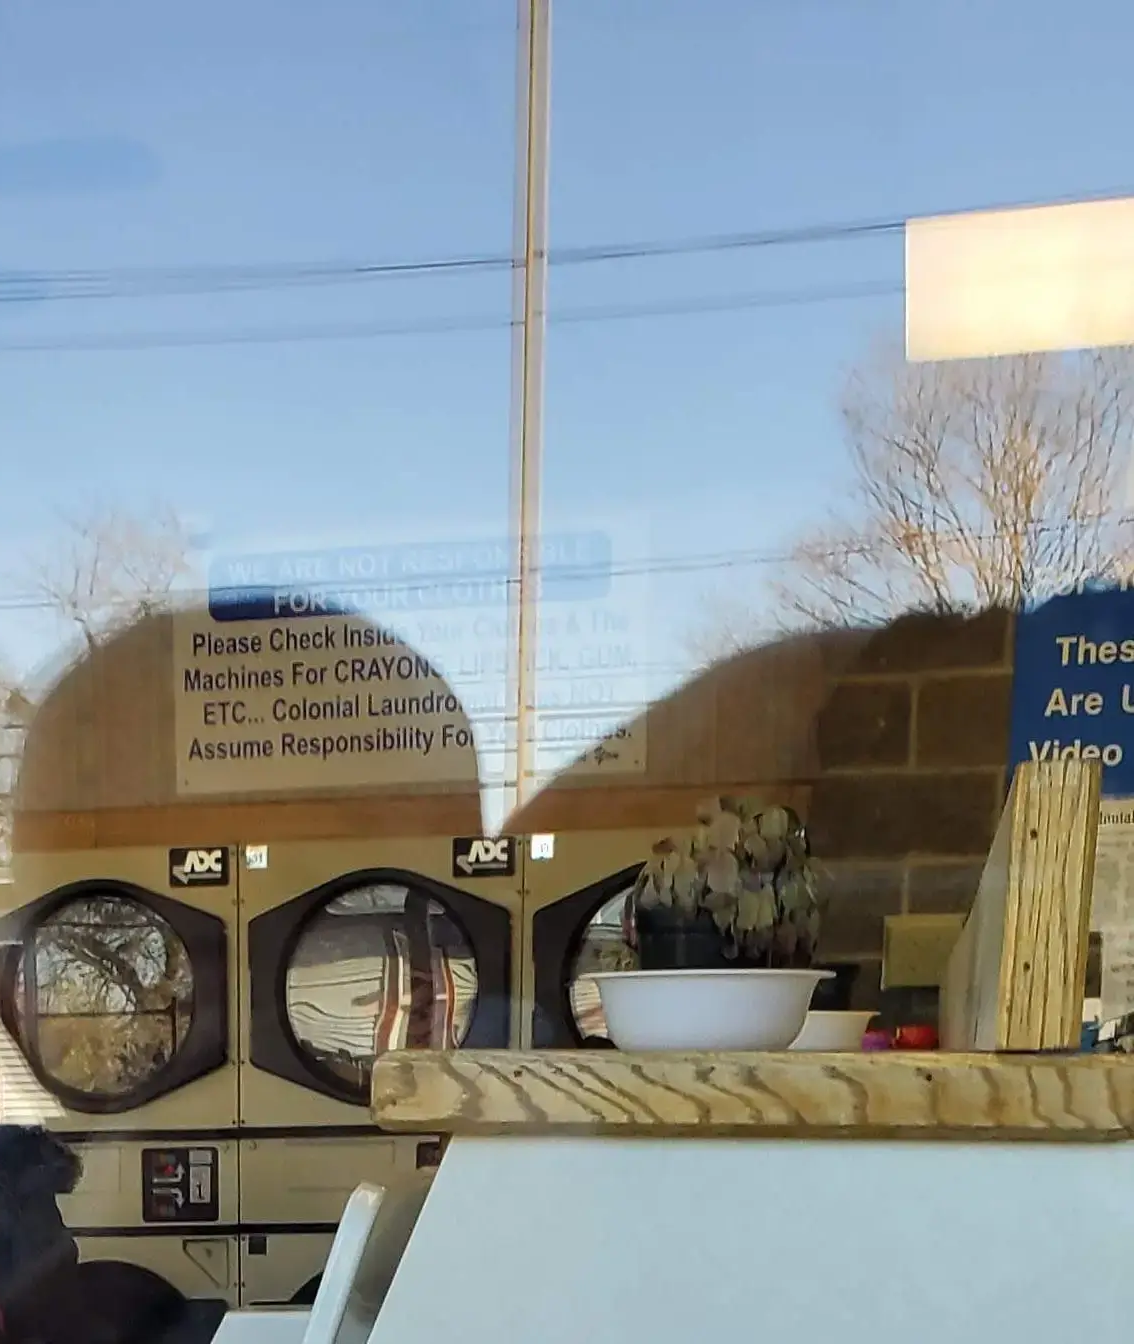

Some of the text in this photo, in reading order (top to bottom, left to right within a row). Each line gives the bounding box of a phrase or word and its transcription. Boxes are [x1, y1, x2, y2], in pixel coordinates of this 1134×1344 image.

[227, 560, 267, 585] WE
[278, 556, 328, 580] ARE
[338, 553, 390, 577] NOT
[274, 590, 328, 615] FOR
[418, 577, 543, 606] CLOTHS
[192, 631, 262, 657] Please
[269, 624, 336, 652] Check
[183, 664, 284, 692] Machines
[292, 661, 327, 685] For
[203, 701, 265, 726] ETC...
[272, 694, 360, 722] Colonial
[1044, 687, 1104, 717] Are
[188, 737, 274, 762] Assume
[281, 725, 434, 761] Responsibility
[1028, 739, 1124, 766] Video
[183, 848, 222, 873] ADC
[467, 838, 509, 864] ADC
